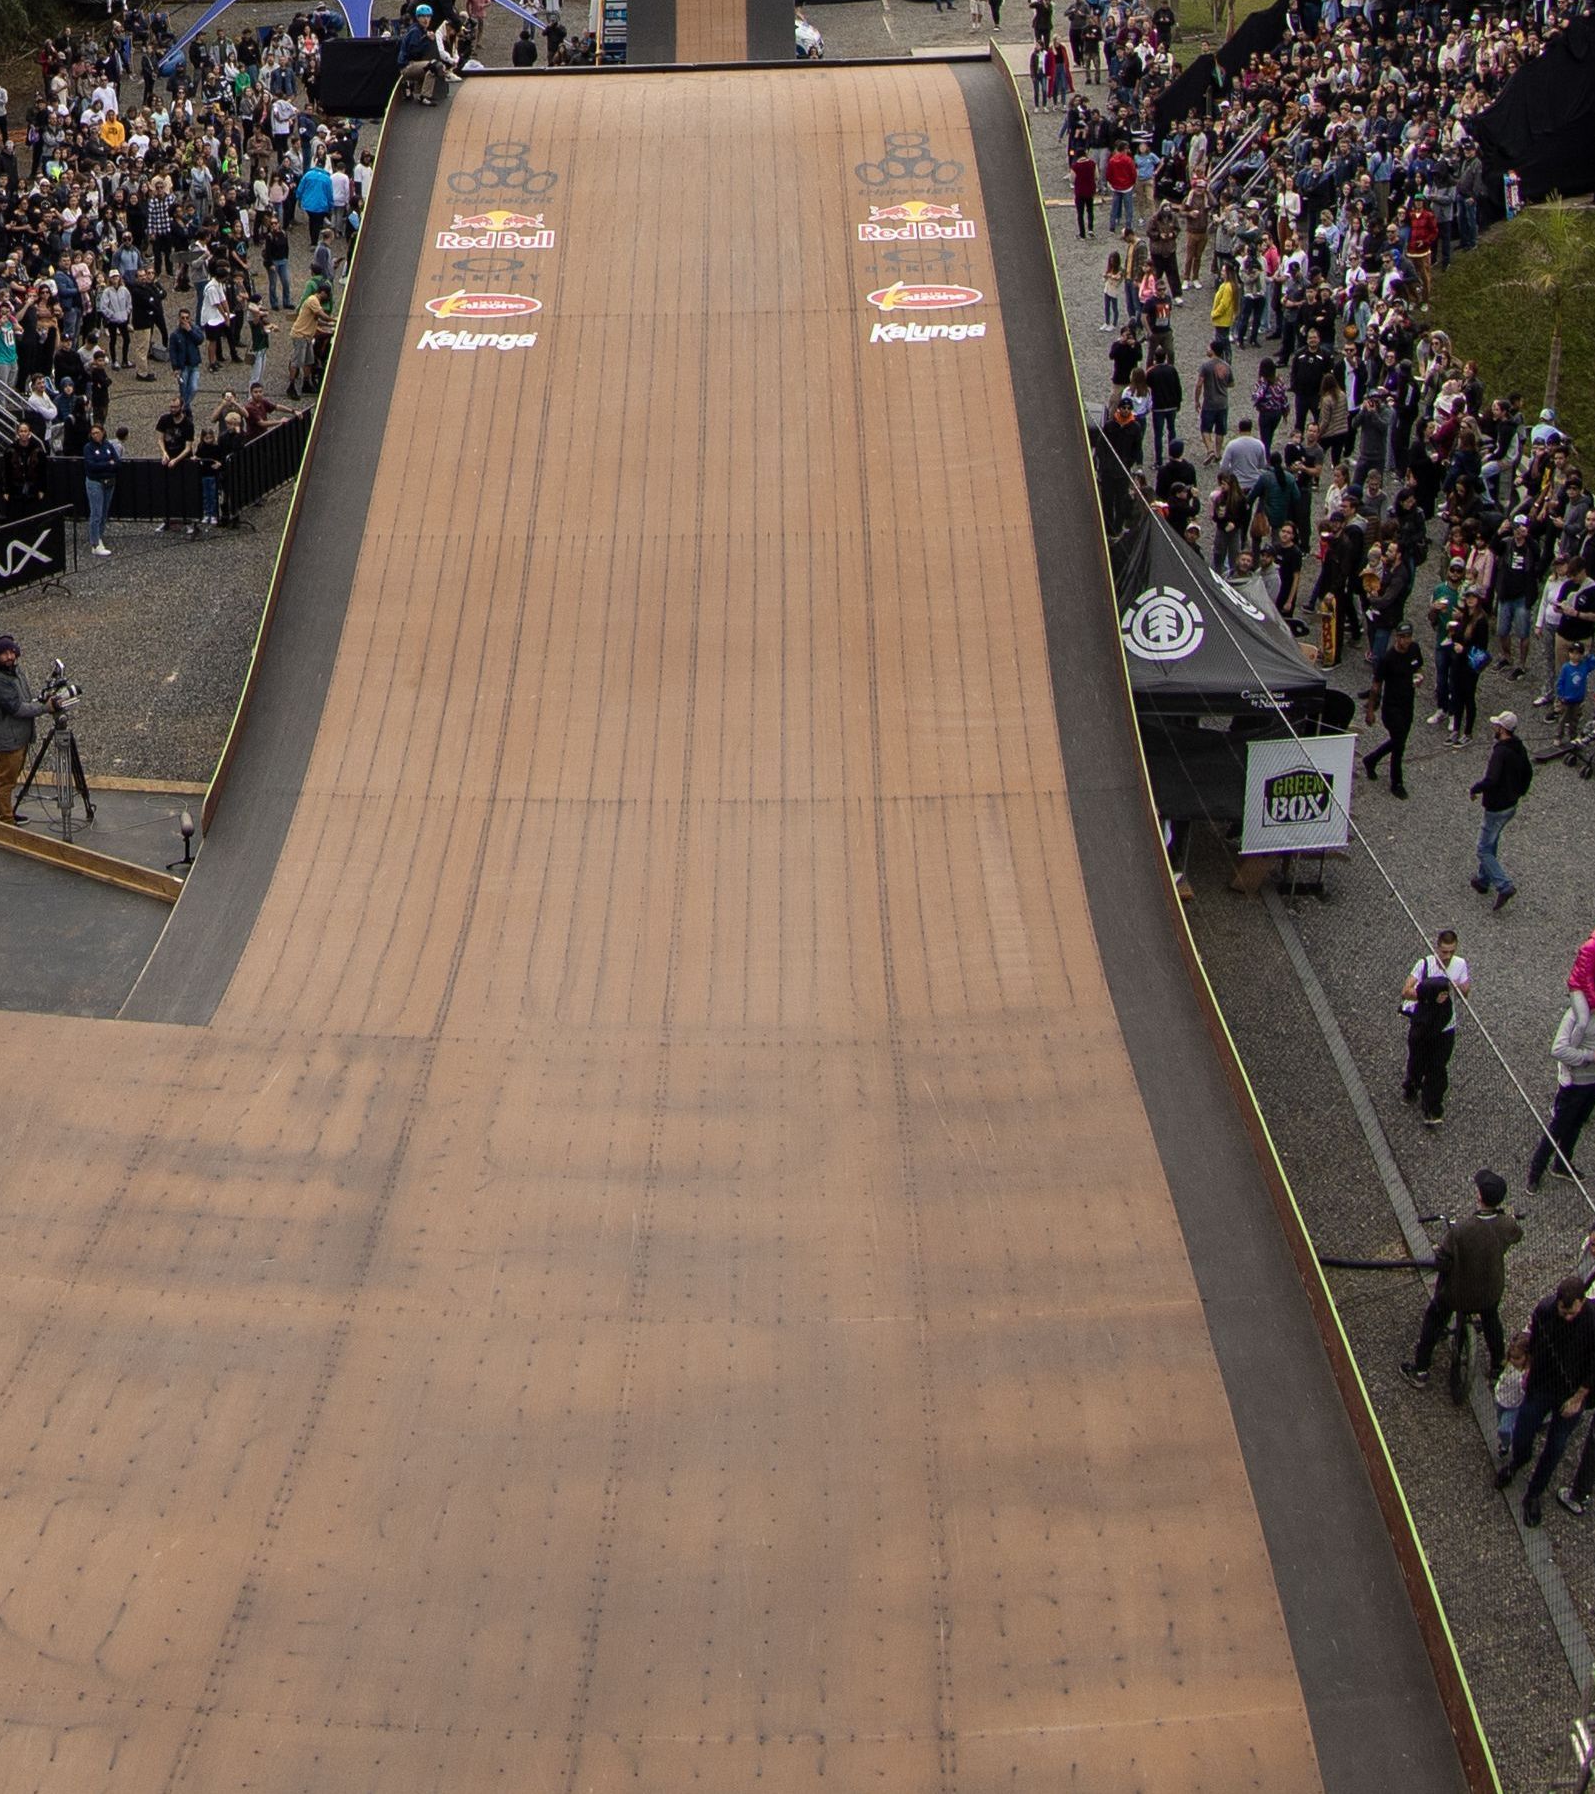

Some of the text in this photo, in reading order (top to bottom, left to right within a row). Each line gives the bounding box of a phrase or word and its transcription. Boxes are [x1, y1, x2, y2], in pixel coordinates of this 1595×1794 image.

[437, 230, 555, 249] Red Bull
[858, 220, 976, 241] Red Bull
[431, 273, 540, 282] OAKLEY
[865, 263, 976, 273] OAKLEY
[1273, 774, 1324, 796] GREEN
[1271, 794, 1324, 821] BOX
